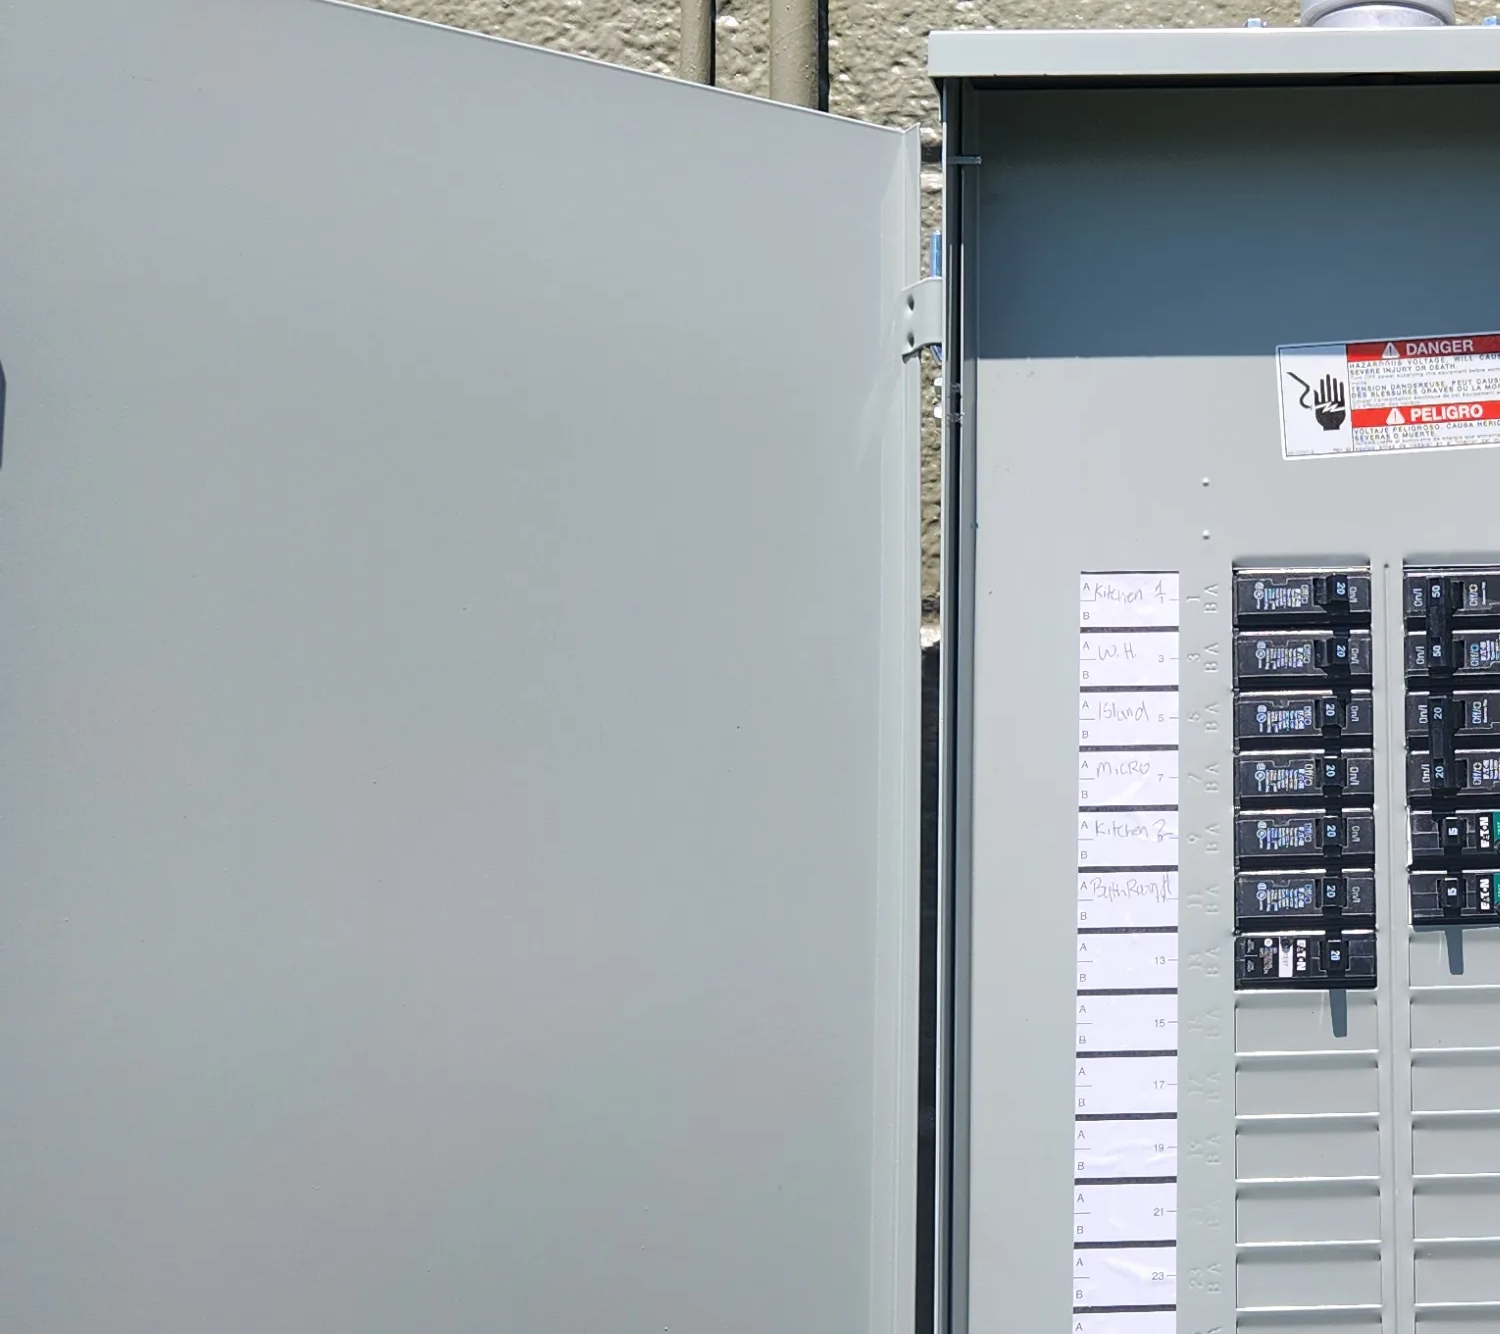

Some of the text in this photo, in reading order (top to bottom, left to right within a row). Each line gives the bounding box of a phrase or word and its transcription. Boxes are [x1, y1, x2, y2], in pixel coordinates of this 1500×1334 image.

[1406, 339, 1474, 356] DANGER
[1410, 404, 1483, 422] PELIGRO
[1336, 581, 1346, 595] 20
[1431, 585, 1441, 598] 50
[1336, 644, 1346, 658] 20
[1432, 645, 1441, 657] 50
[1158, 655, 1164, 663] 3
[1325, 703, 1335, 716] 20
[1433, 707, 1442, 720] 20
[1158, 714, 1164, 722] 5
[1326, 764, 1335, 778] 20
[1435, 765, 1444, 778] 20
[1157, 774, 1164, 782] 7
[1326, 825, 1337, 838] 20
[1326, 885, 1336, 898] 20
[1154, 957, 1166, 965] 13
[1330, 950, 1340, 961] 20
[1154, 1019, 1165, 1027] 15
[1153, 1081, 1165, 1089] 17
[1153, 1143, 1164, 1151] 19
[1153, 1207, 1164, 1216] 21
[1152, 1272, 1165, 1281] 23
